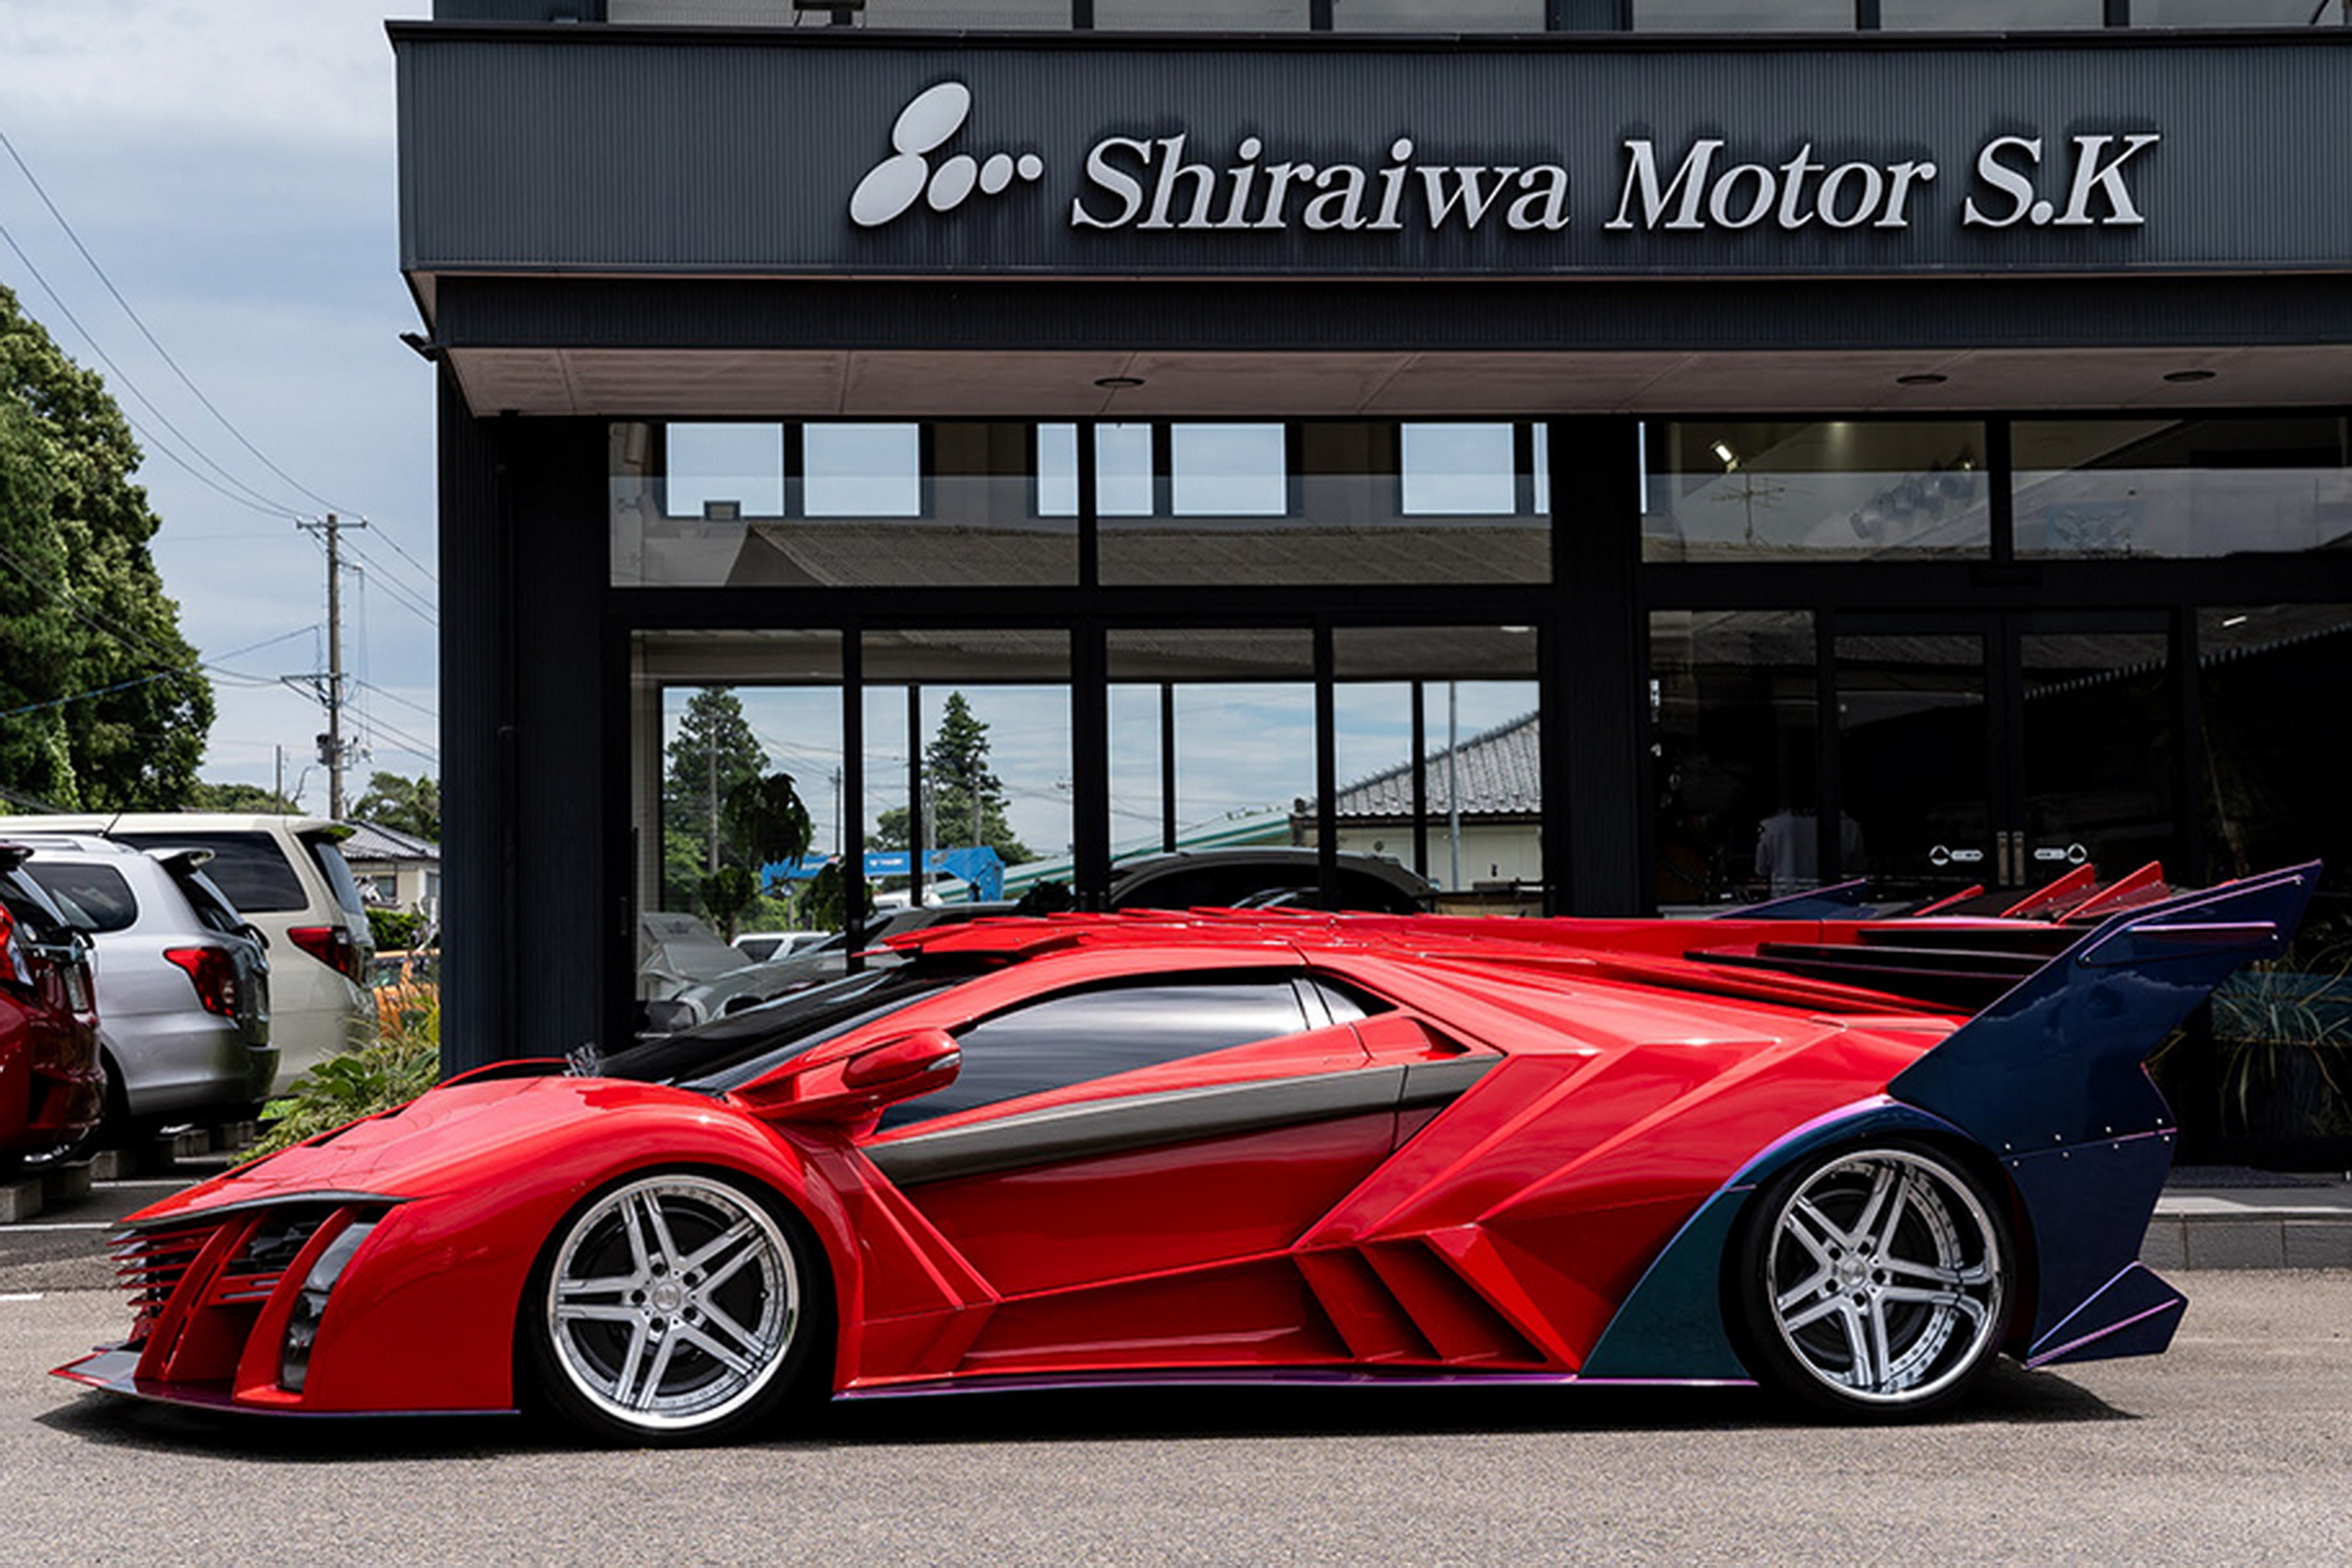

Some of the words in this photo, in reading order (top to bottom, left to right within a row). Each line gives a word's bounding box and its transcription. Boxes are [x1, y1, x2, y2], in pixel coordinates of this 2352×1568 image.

[1071, 135, 1570, 230] Shiraiwa
[1603, 139, 1936, 230] Motor
[1963, 135, 2161, 228] S.K
